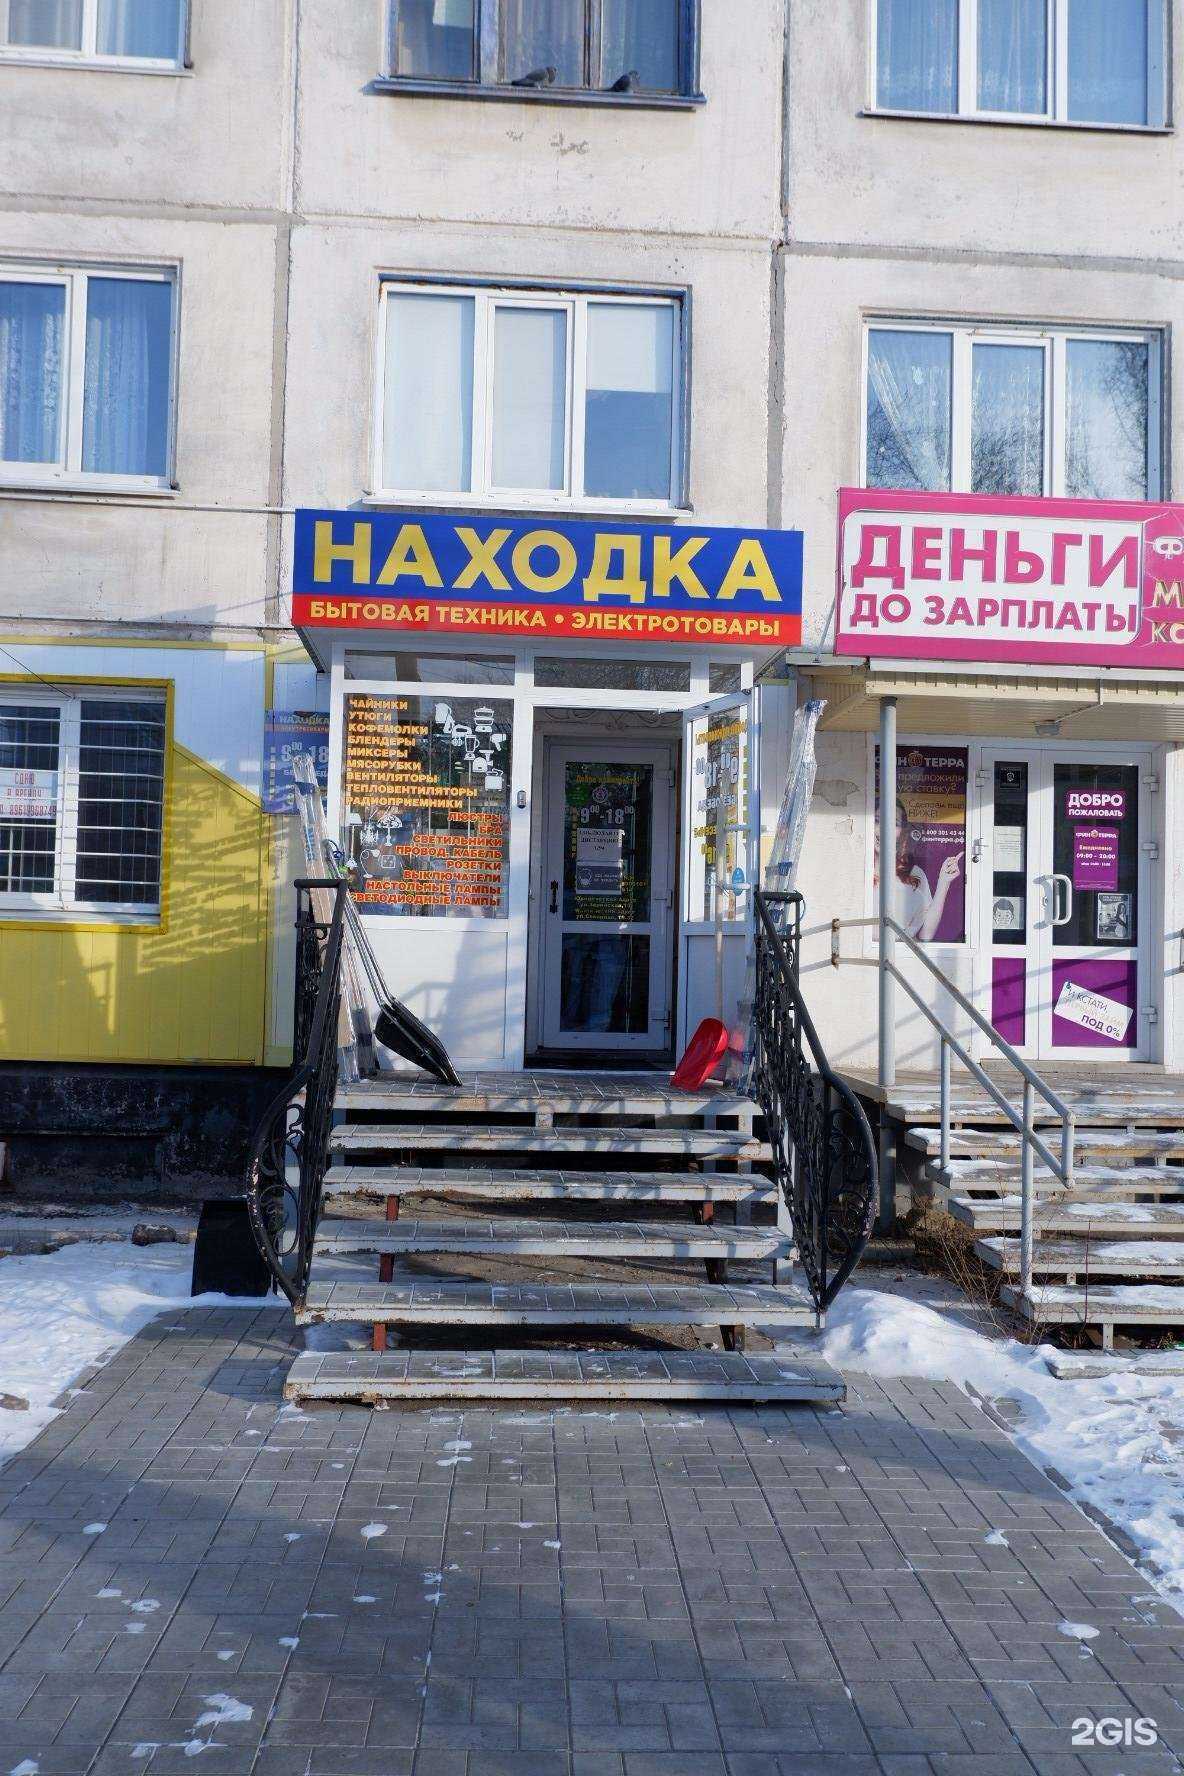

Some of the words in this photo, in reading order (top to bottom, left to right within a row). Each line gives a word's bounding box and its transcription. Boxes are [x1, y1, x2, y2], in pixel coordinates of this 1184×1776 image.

[312, 520, 782, 604] НАХОДКА
[851, 524, 1139, 590] ДЕНЬГИ
[309, 601, 430, 623] БЫТОВАЯ
[436, 606, 547, 627] ТЕХНИКА
[571, 611, 781, 637] ЭЛЕКТРОТОВАРЫ
[850, 593, 912, 628] ДО
[922, 596, 1137, 633] ЗАРПЛАТЫ
[349, 698, 408, 710] ЧАЙНИКИ
[349, 711, 392, 721] УТЮГИ
[348, 723, 428, 735] КОФЕМОЛКИ
[348, 735, 416, 747] БЛЕНДЕРЫ
[347, 747, 408, 758] МИКСЕРЫ
[347, 759, 421, 771] МЯСОРУБКИ
[924, 757, 965, 768] ТЕРРА
[346, 772, 438, 783] ВЕНТИЛЯТОРЫ
[345, 783, 478, 797] ТЕПЛОВЕНТИЛЯТОРЫ
[345, 796, 463, 809] РАДИОПРИЕМНИКИ
[1068, 793, 1123, 808] ДОБРО
[447, 811, 503, 823] ЛЮСТРЫ
[1068, 809, 1123, 817] ПОЖАЛОВАТЬ
[478, 824, 503, 835] БРА
[412, 834, 503, 847] СВЕТИЛЬНИКИ
[453, 847, 503, 859] КАБЕЛЬ
[446, 860, 502, 871] РОЗЕТКИ
[403, 870, 502, 883] ВЫКЛЮЧАТЕЛИ
[365, 881, 451, 894] НАСТОЛЬНЫЕ
[454, 884, 502, 895] ЛАМПЫ
[453, 895, 501, 907] ЛАМПЫ
[1081, 1014, 1105, 1032] ПОД
[1106, 1025, 1120, 1038] 0%
